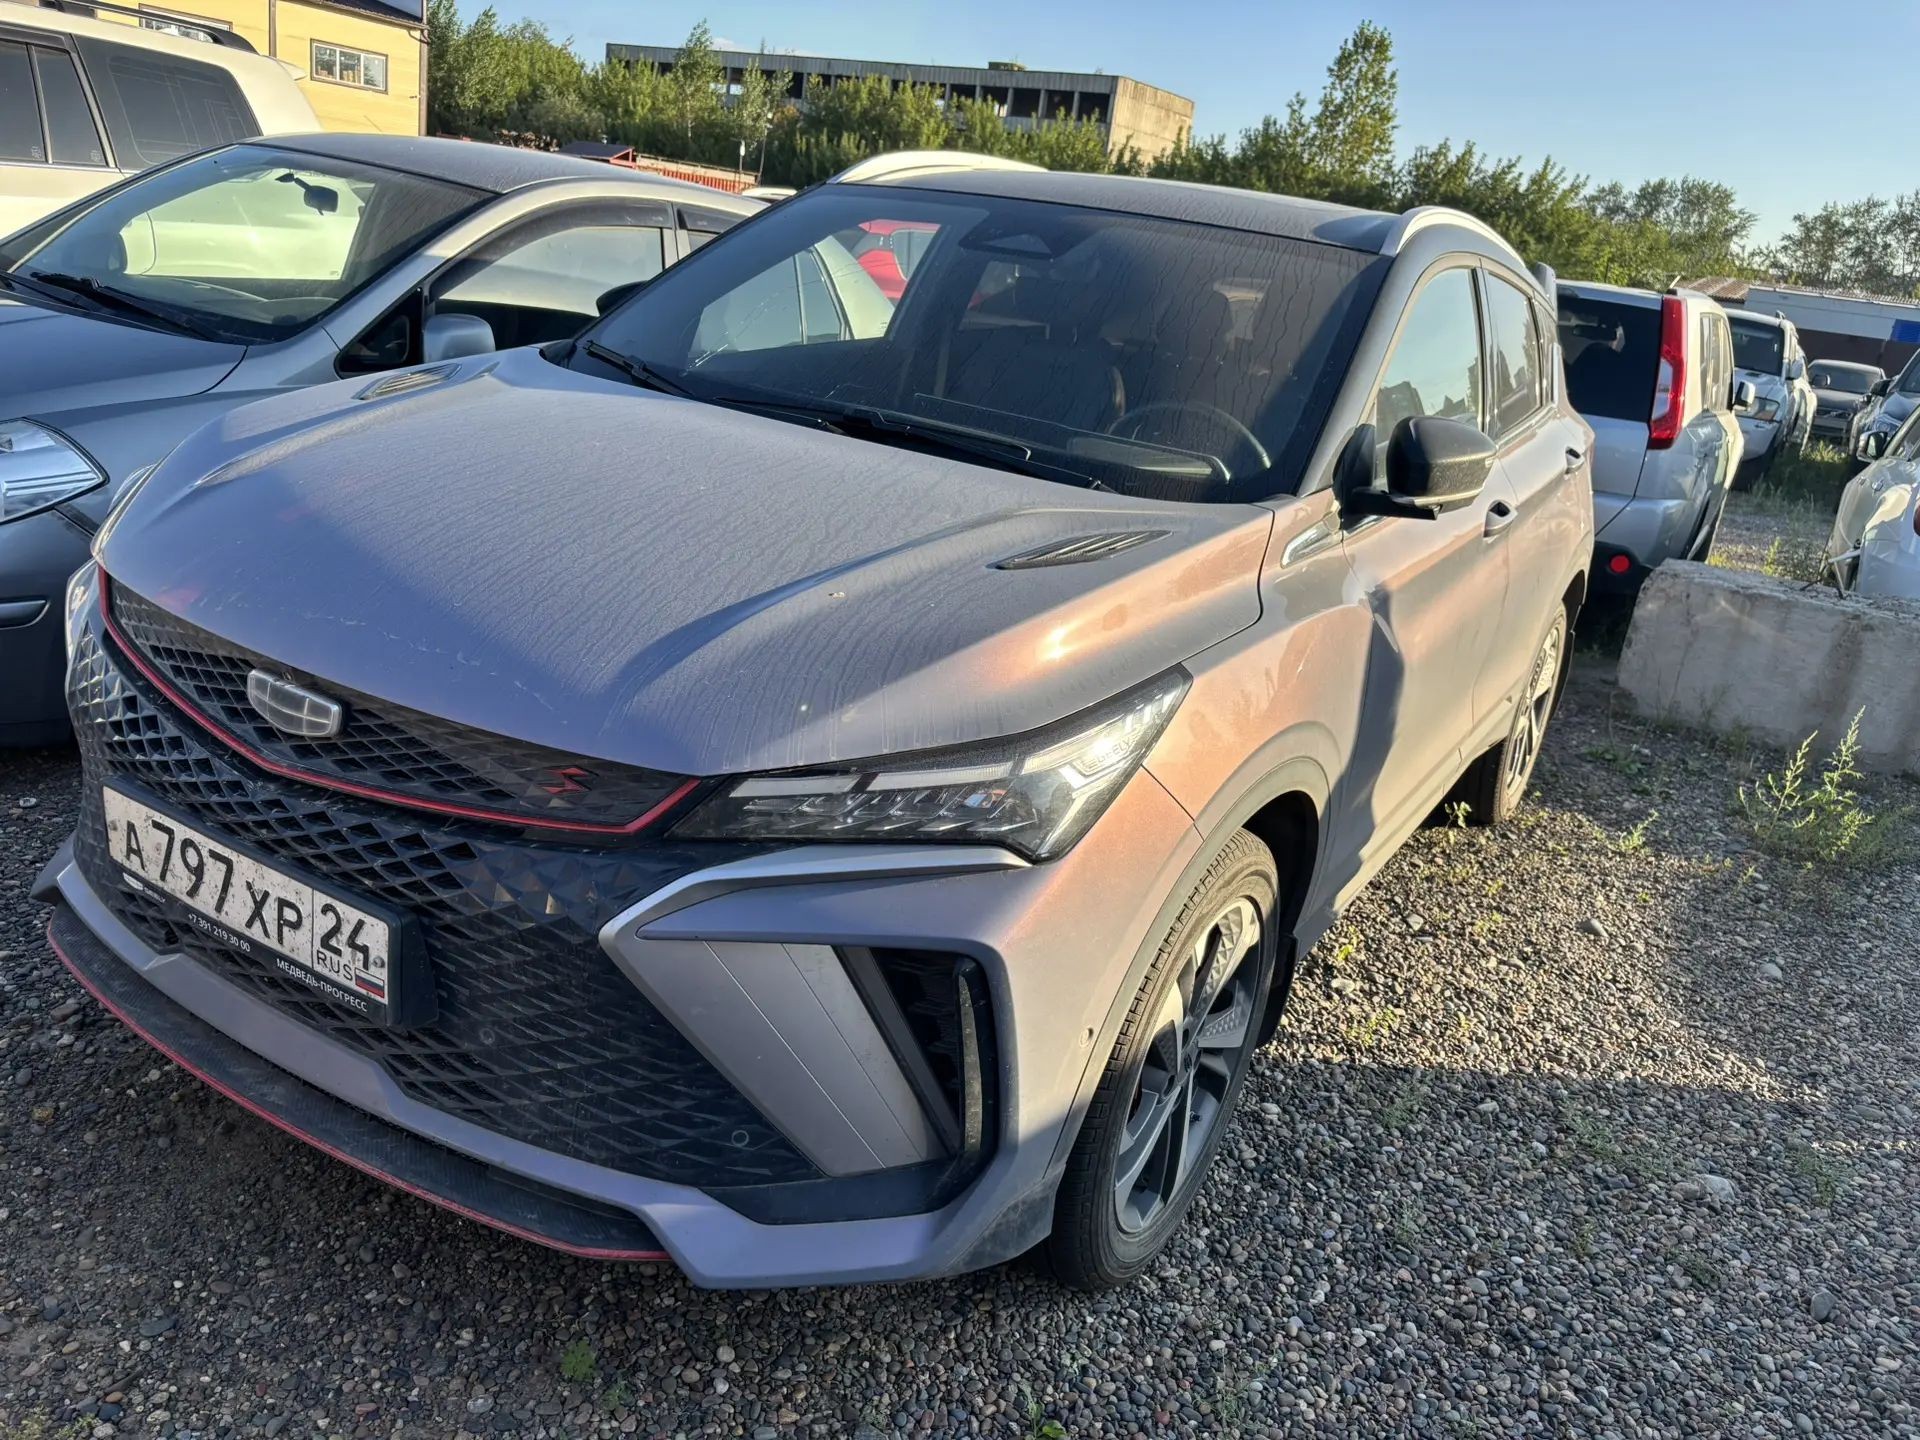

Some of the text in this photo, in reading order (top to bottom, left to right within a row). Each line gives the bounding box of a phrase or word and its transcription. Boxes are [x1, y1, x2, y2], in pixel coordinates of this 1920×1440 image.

[126, 820, 369, 971] А797ХР 24
[188, 913, 251, 952] +7 391 219 30 00
[276, 958, 367, 1012] МЕДВЕДЬ-ПРОГРЕСС
[316, 949, 353, 981] RUS
